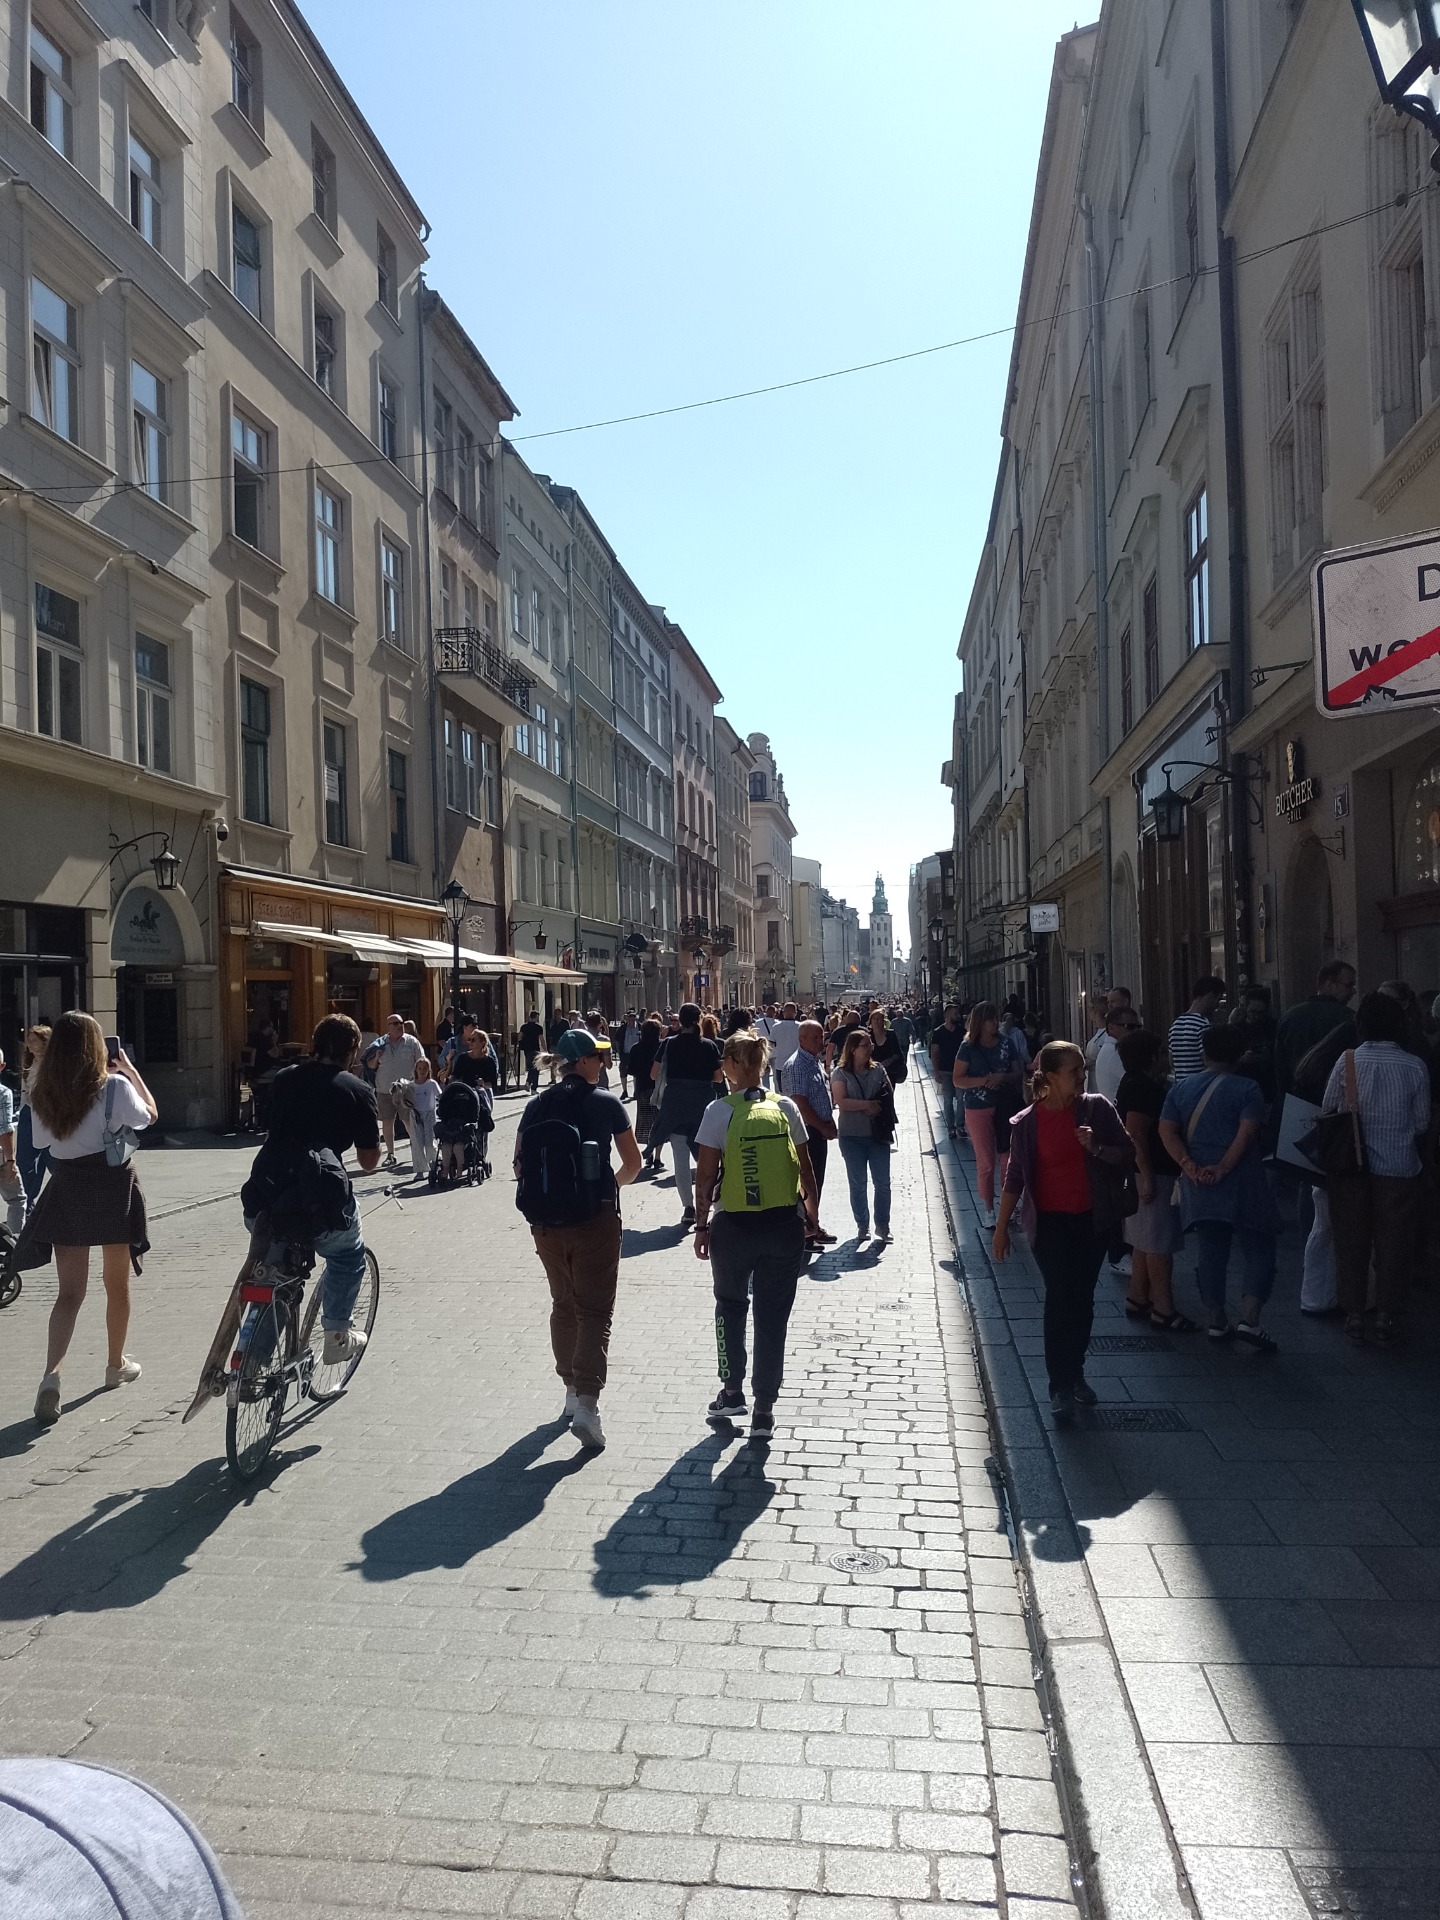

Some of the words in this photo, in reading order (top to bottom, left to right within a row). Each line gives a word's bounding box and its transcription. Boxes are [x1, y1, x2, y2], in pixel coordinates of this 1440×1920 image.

[1275, 777, 1314, 817] BUTCHER
[1286, 807, 1302, 825] GRILL
[741, 1145, 760, 1184] PUMA
[716, 1315, 731, 1380] adidas
